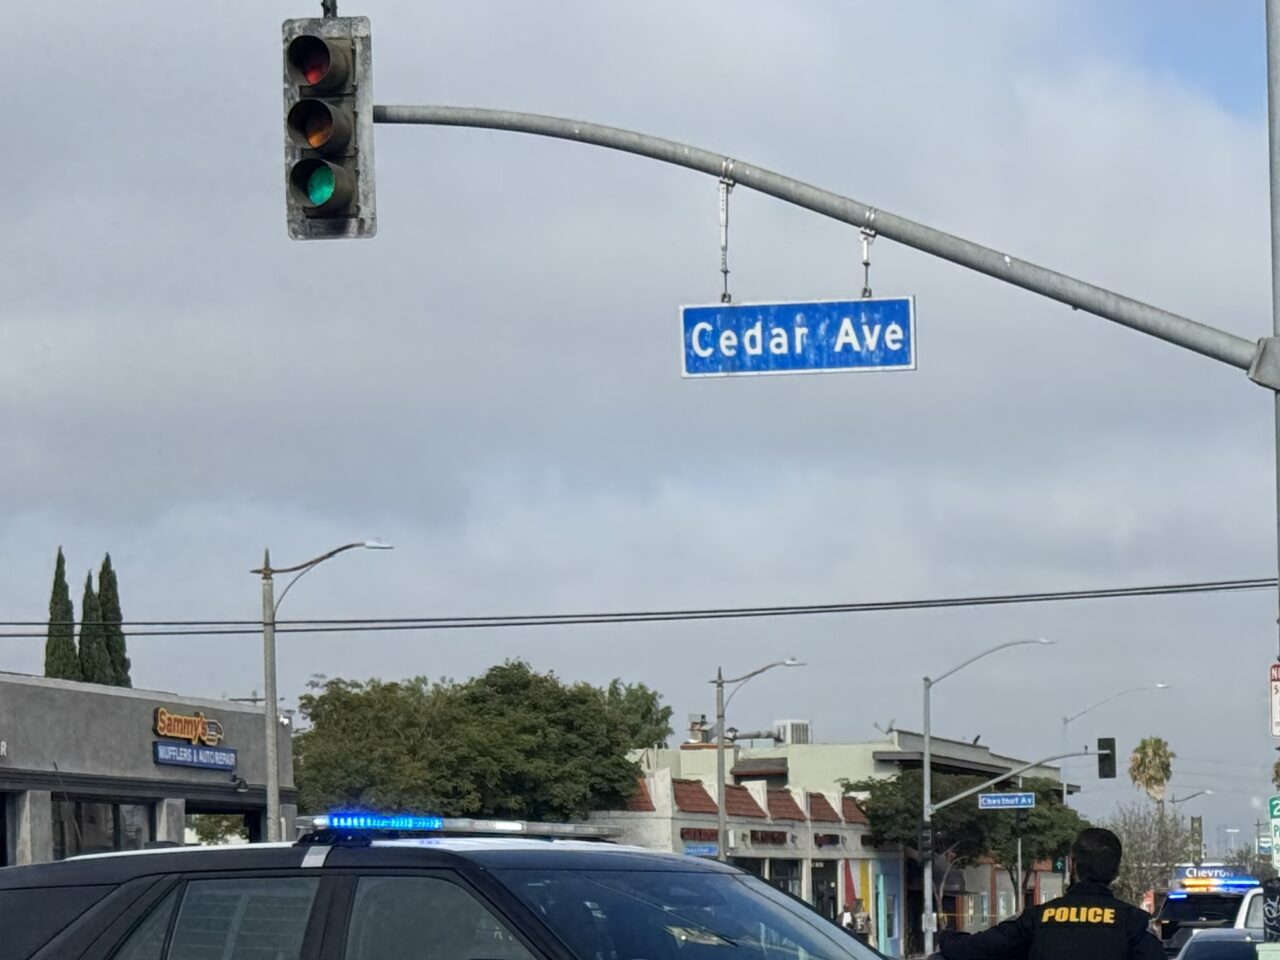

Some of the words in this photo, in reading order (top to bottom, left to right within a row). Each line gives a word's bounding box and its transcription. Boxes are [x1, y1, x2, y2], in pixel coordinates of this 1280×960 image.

[692, 320, 809, 357] Cedar
[834, 317, 904, 352] Ave
[157, 707, 208, 744] Sammy's
[158, 745, 192, 762] MUFFLERS
[199, 750, 214, 764] AUTO
[215, 751, 236, 767] REPAIR
[981, 796, 1019, 806] Chestnut
[1041, 906, 1116, 924] POLICE
